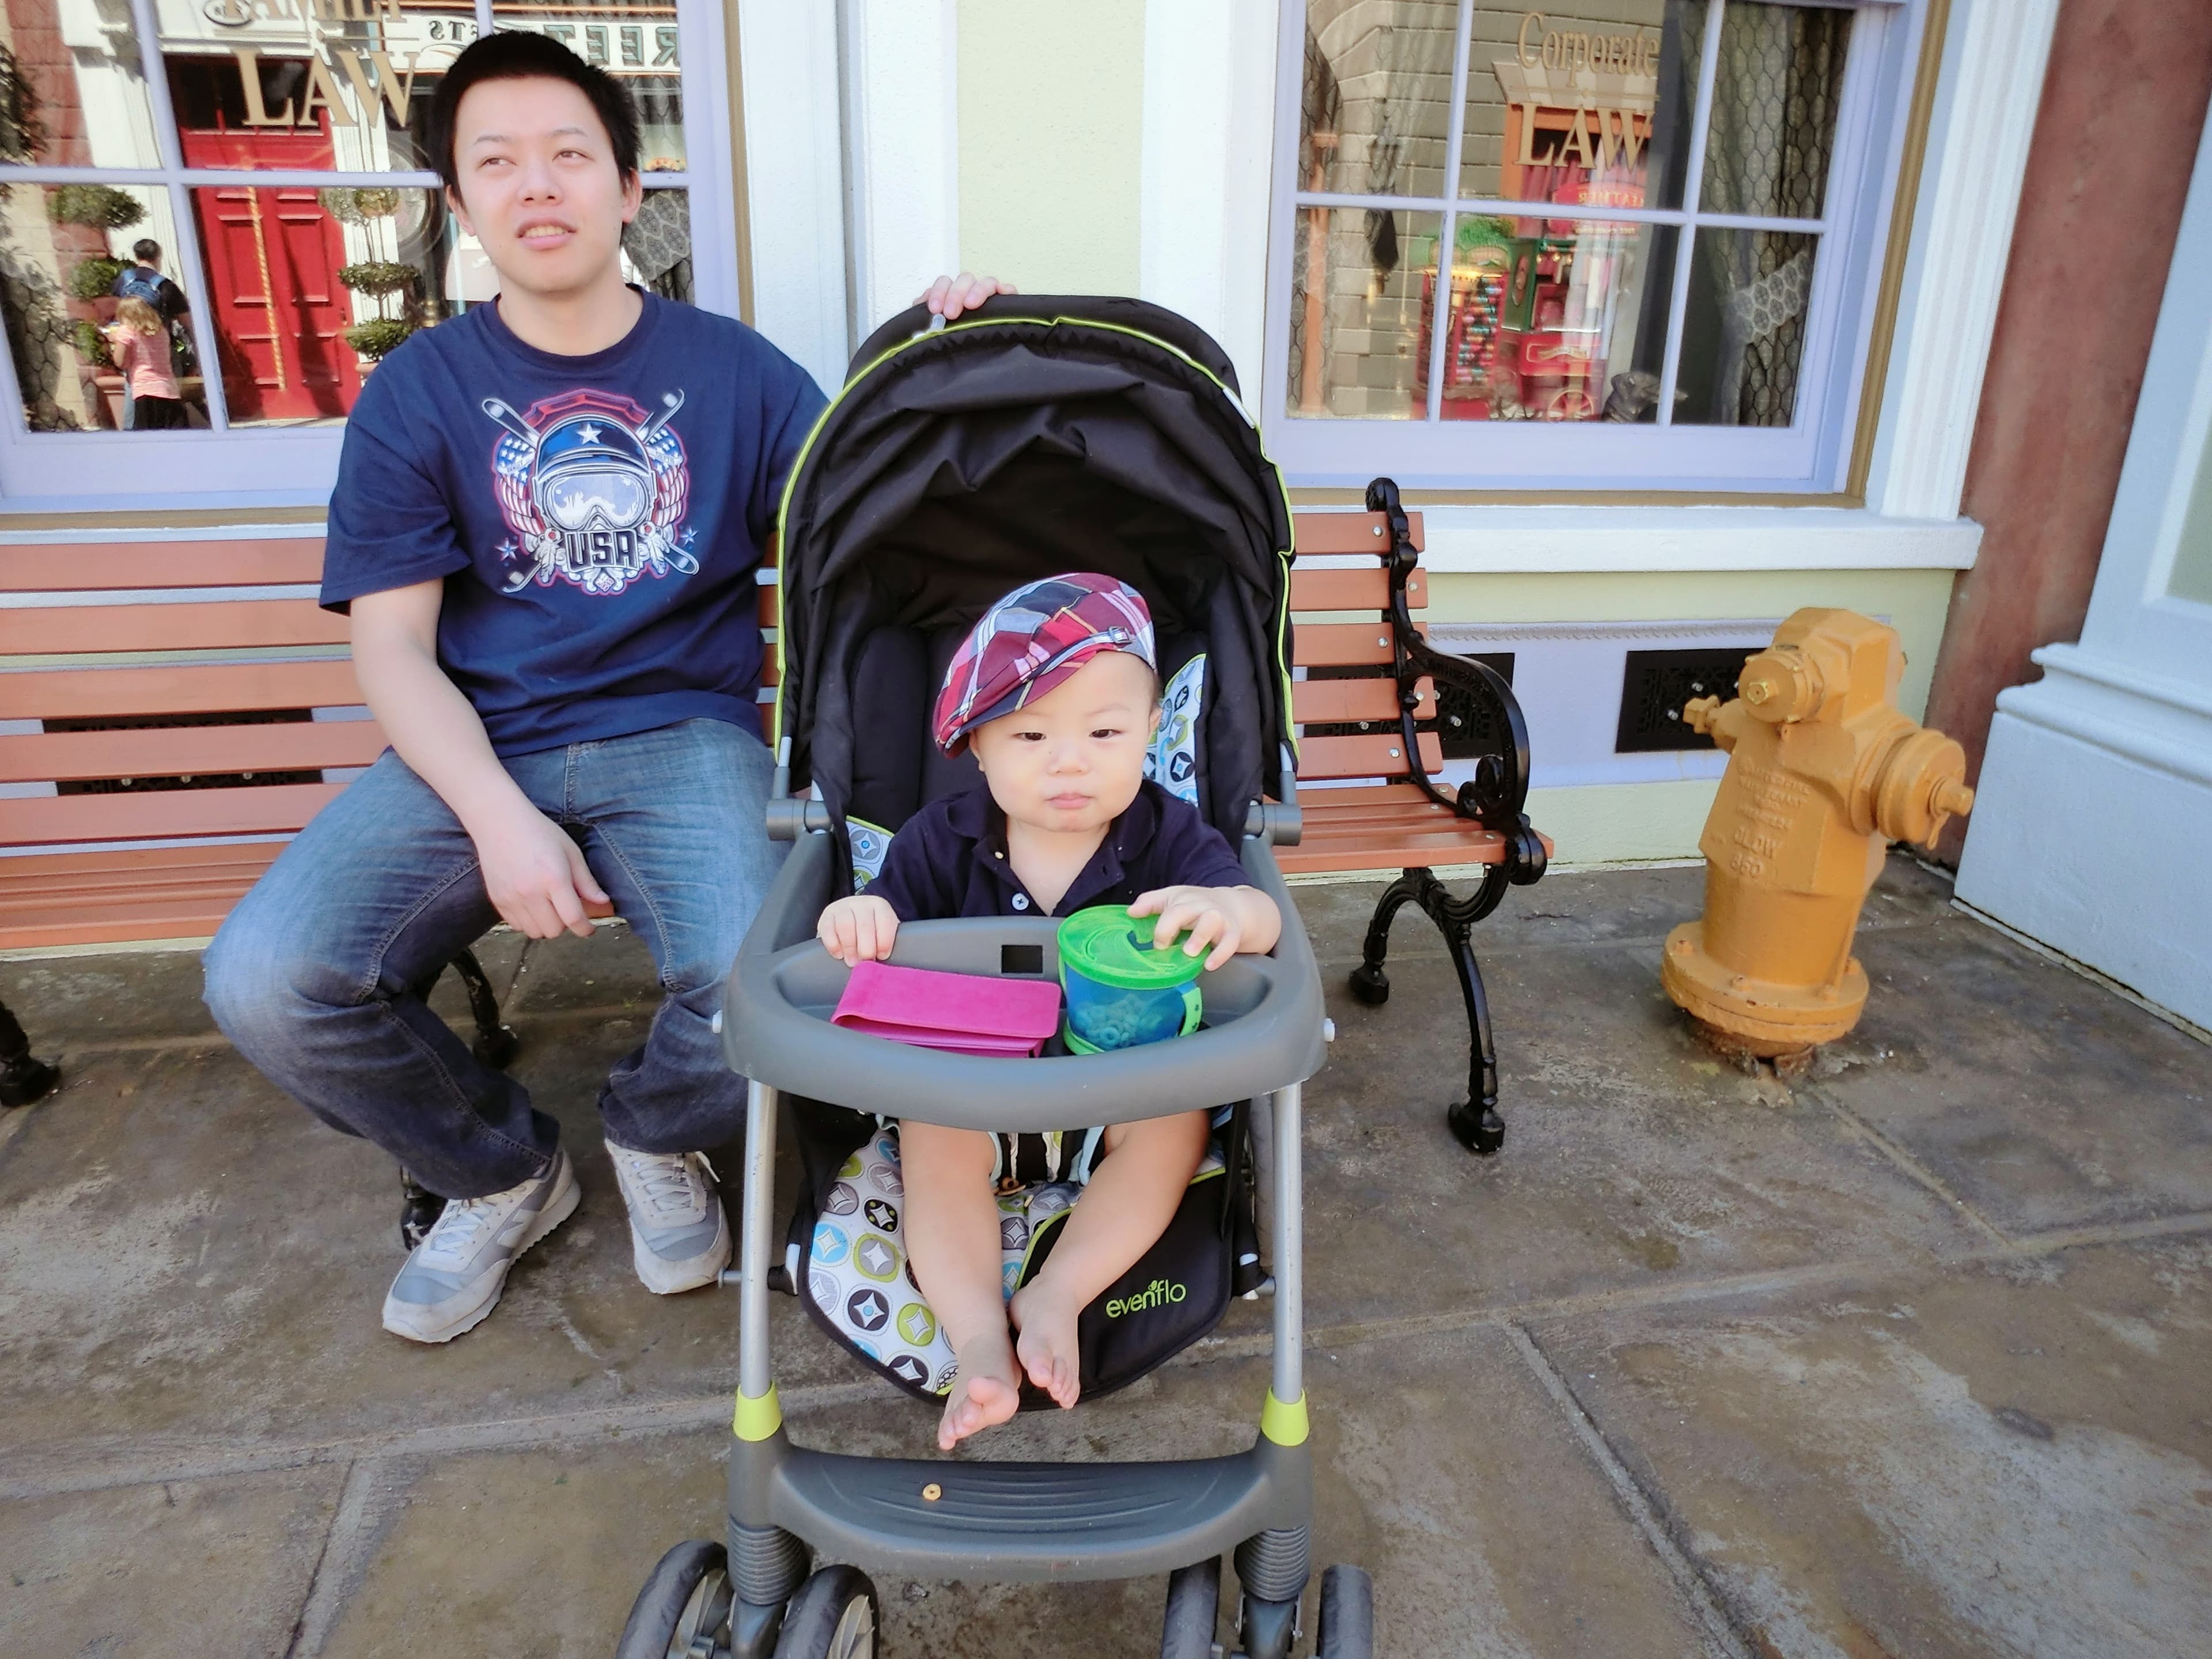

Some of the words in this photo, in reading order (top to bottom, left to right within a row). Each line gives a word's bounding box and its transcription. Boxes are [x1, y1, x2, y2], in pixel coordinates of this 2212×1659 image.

[1517, 12, 1660, 88] Corporate
[232, 46, 420, 128] LAW
[1514, 103, 1655, 172] LAW
[565, 530, 639, 573] USA
[1106, 1279, 1186, 1318] evenflo
